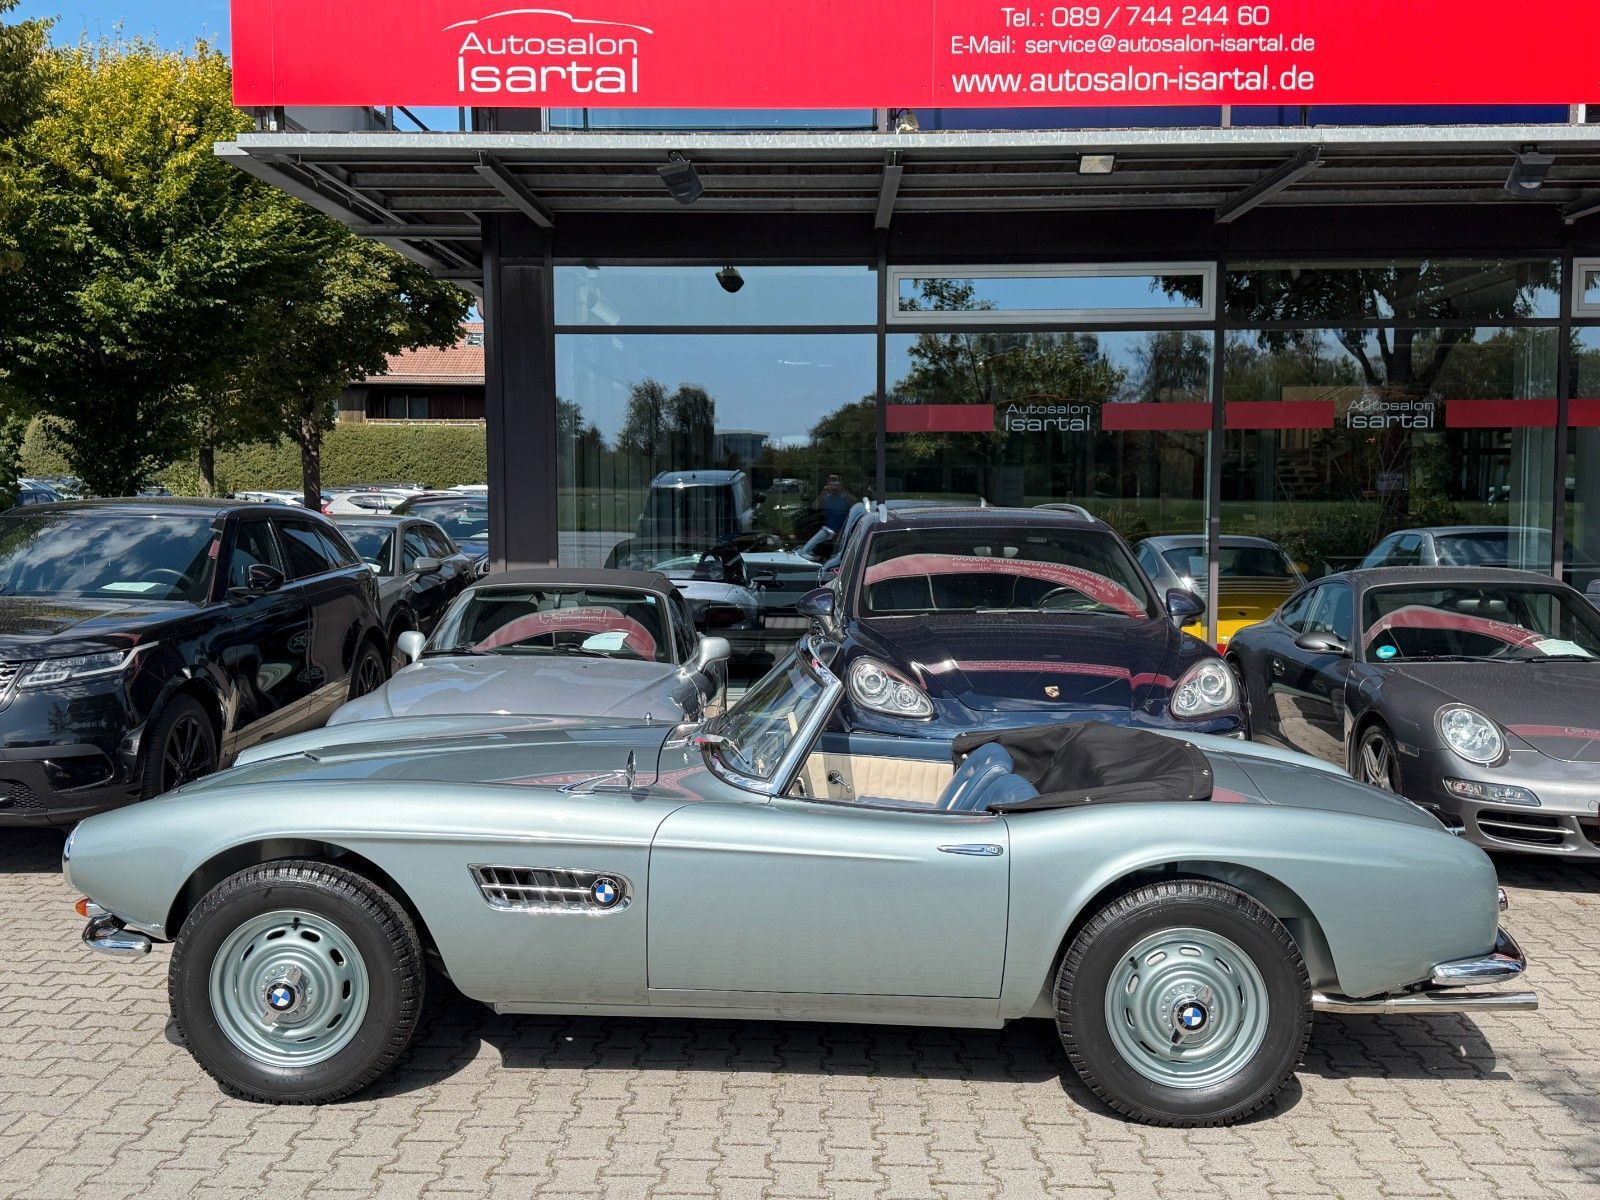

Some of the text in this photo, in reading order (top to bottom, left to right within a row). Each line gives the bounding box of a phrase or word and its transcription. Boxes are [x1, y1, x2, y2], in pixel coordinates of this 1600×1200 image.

[1001, 7, 1044, 28] Tel.:
[1181, 6, 1229, 26] 244
[1237, 6, 1270, 26] 60
[459, 32, 638, 55] Autosalon
[951, 34, 1315, 54] E-Mail: service@autosalon-isartal.de
[457, 56, 638, 93] Isartal
[952, 65, 1314, 93] www.autosalon-isartal.de
[1006, 403, 1091, 414] Autosalon
[1347, 400, 1434, 411] Autosalon
[1005, 414, 1090, 431] Isartal
[1346, 411, 1434, 428] Isartal
